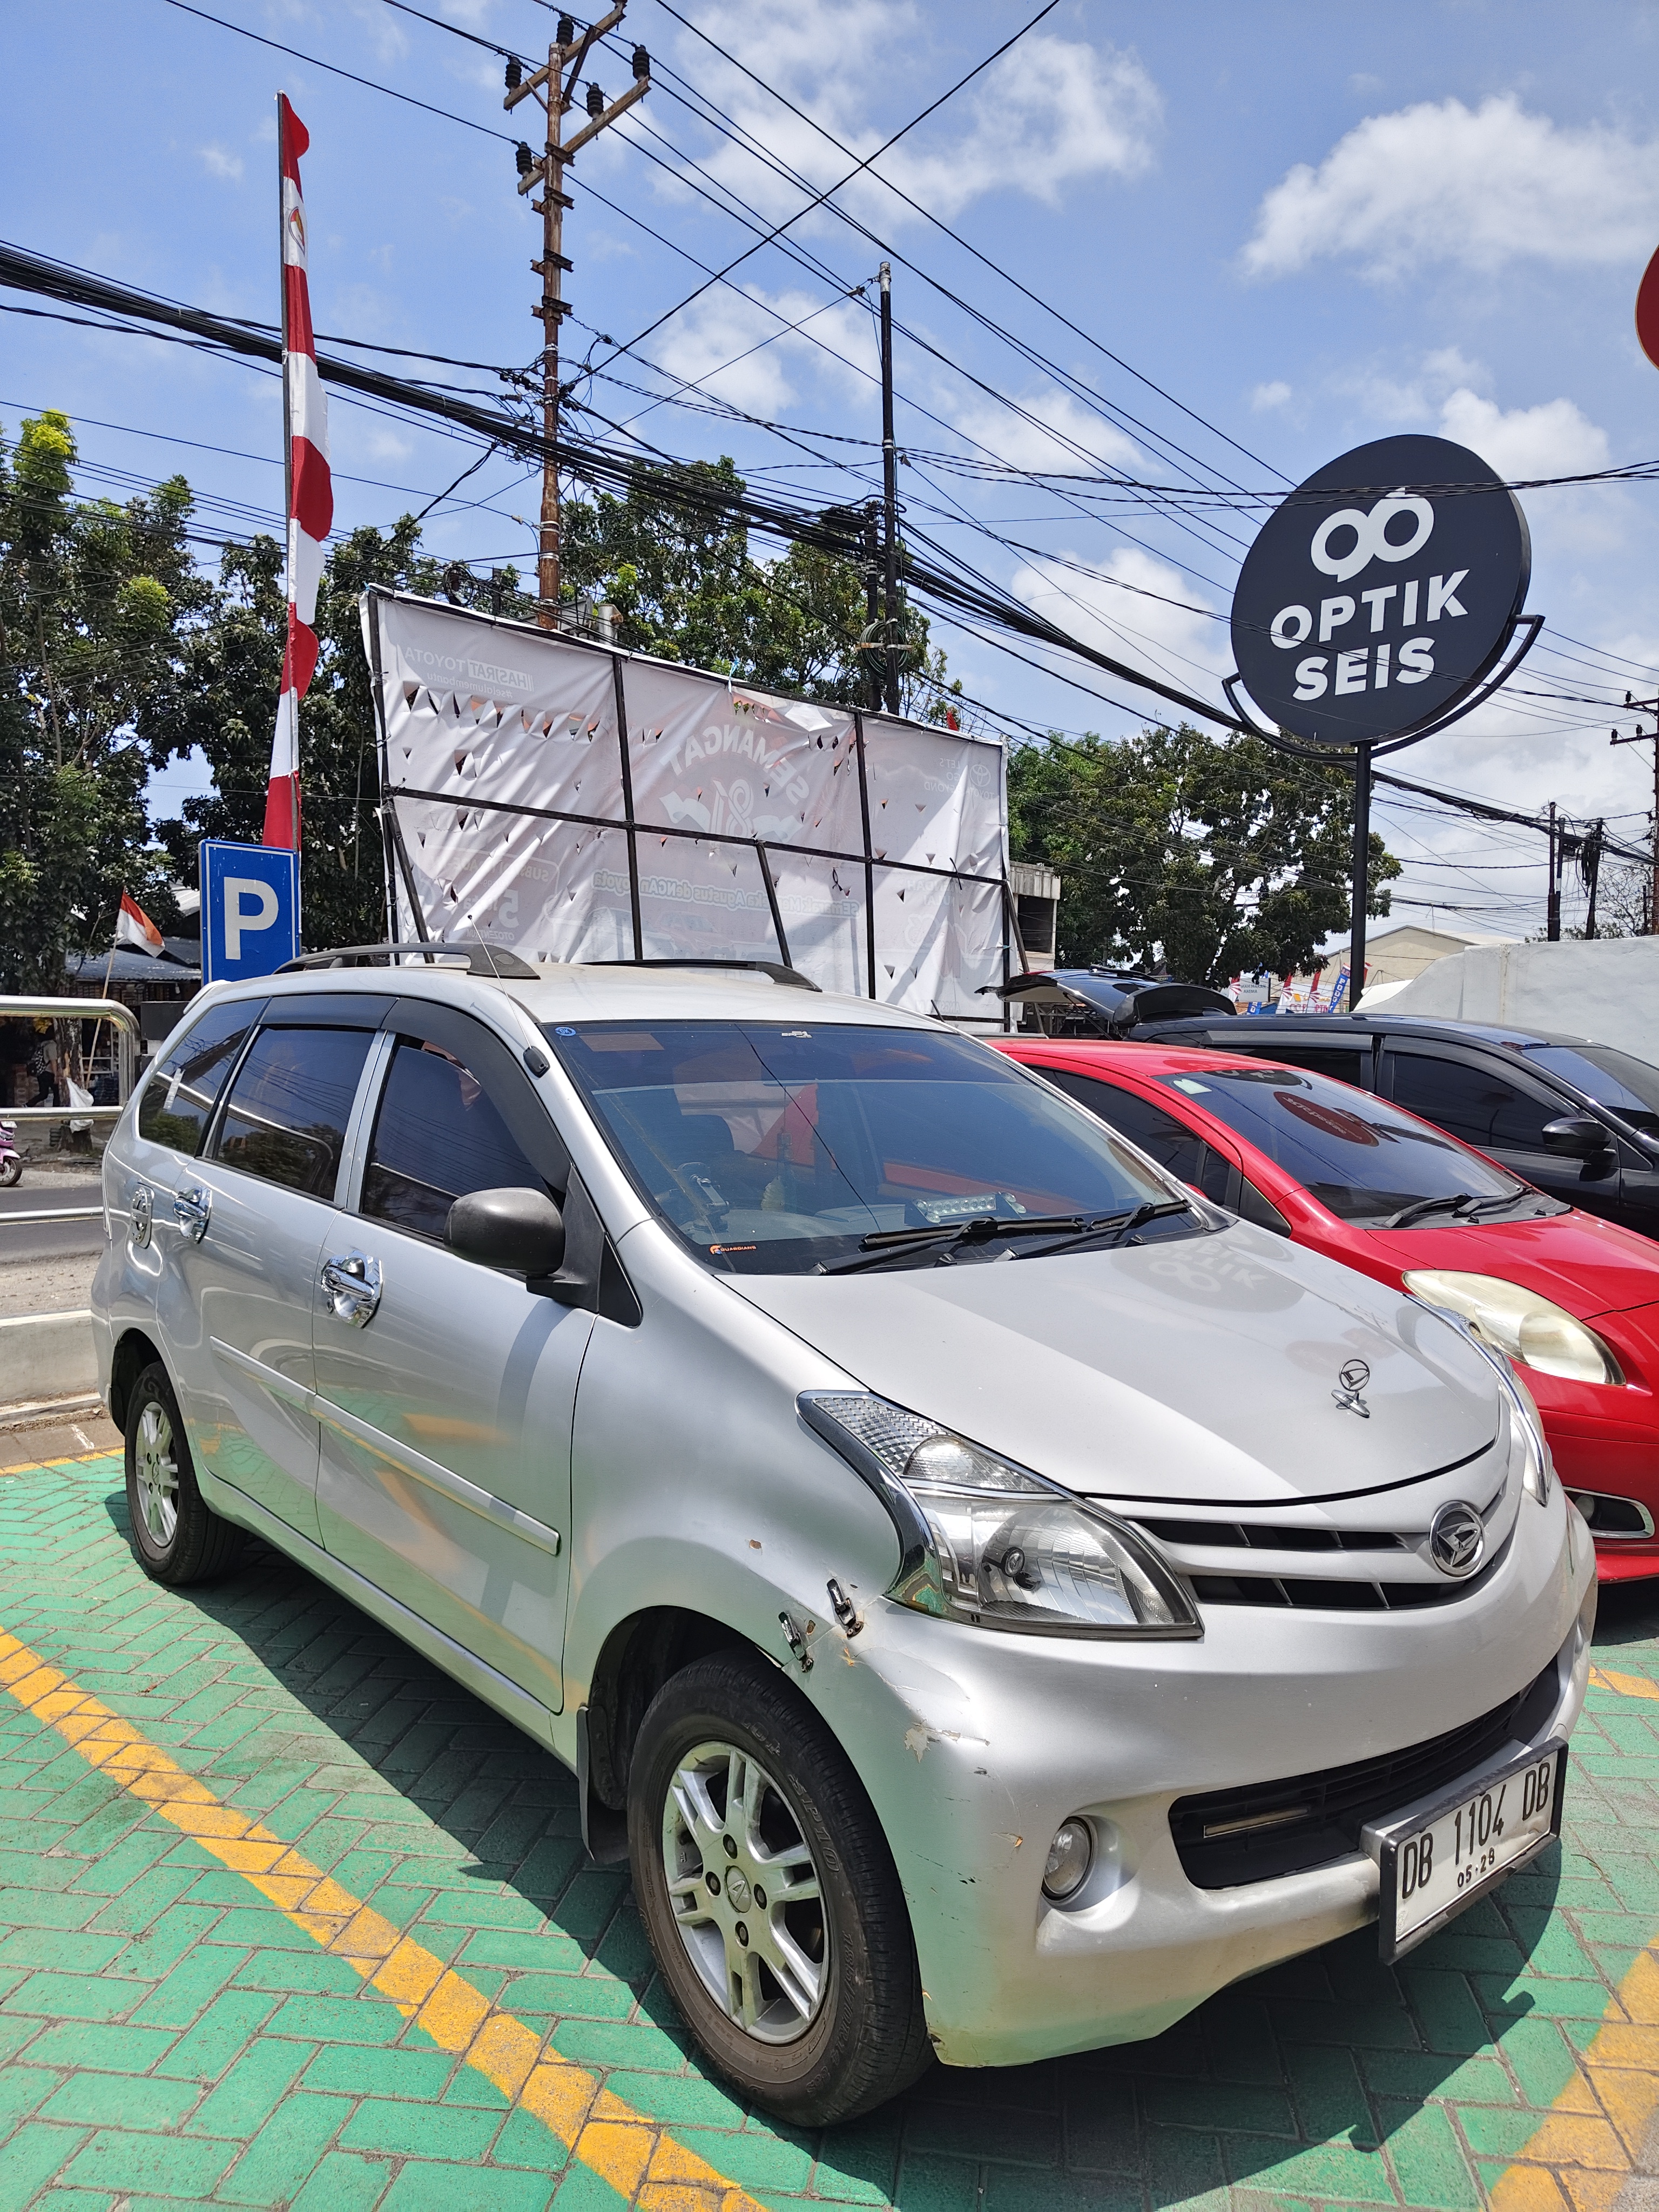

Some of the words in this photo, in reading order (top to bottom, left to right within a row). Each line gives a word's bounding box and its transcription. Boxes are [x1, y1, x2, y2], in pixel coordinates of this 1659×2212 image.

[1270, 569, 1471, 649] OPTIK
[1293, 637, 1436, 701] SEIS
[224, 876, 279, 960] P
[1402, 1832, 1433, 1900] DB
[1454, 1784, 1507, 1866] 1104
[1522, 1762, 1551, 1822] DB
